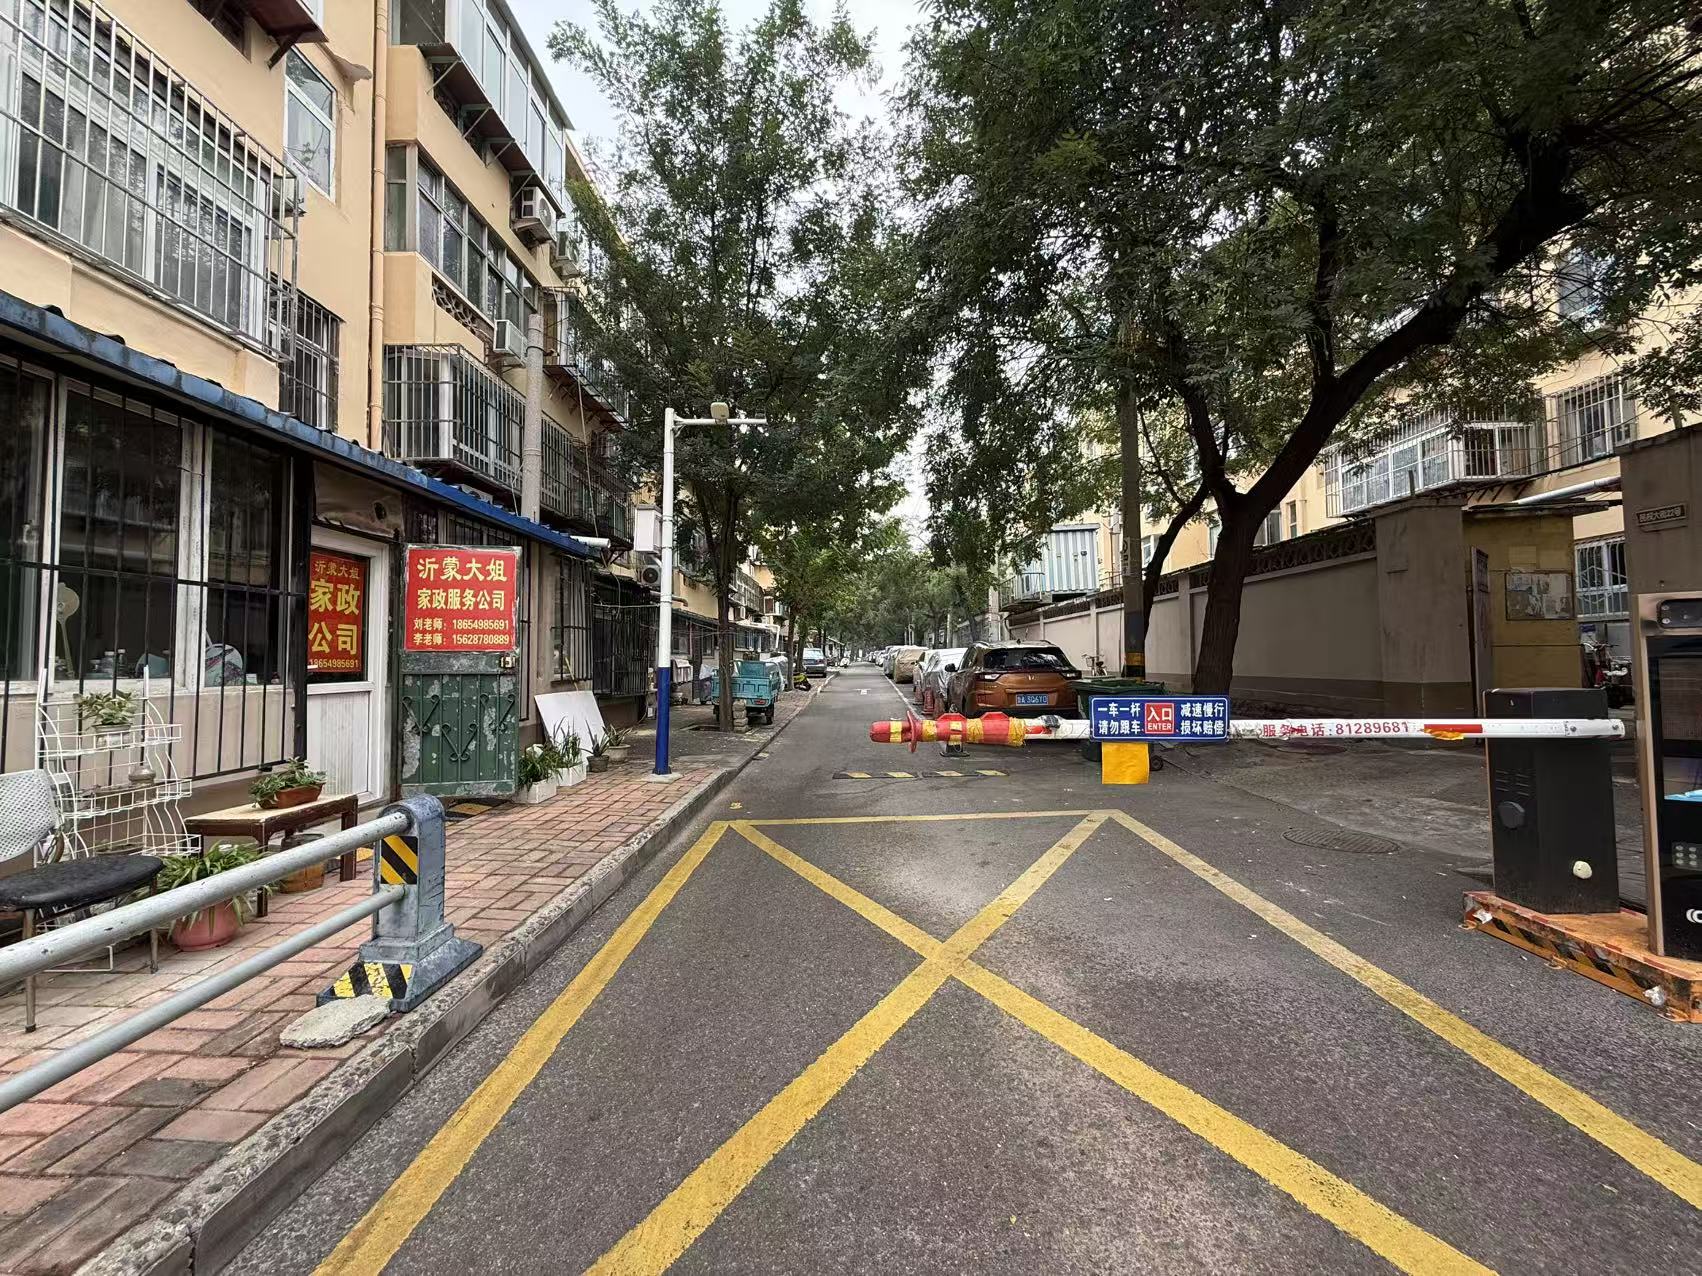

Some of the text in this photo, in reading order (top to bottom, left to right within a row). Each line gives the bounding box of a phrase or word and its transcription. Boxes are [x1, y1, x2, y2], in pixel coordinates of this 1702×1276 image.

[417, 556, 508, 582] 沂蒙大姐
[310, 578, 360, 616] 家政
[417, 588, 505, 611] 家政服务公司
[308, 621, 358, 655] 公司
[1097, 701, 1141, 717] 一车一杆
[1147, 707, 1172, 722] 入口
[1180, 702, 1225, 718] 减速慢行
[1098, 719, 1141, 735] 请勿跟车
[1147, 722, 1172, 731] ENTER
[1180, 719, 1225, 735] 损坏赔偿
